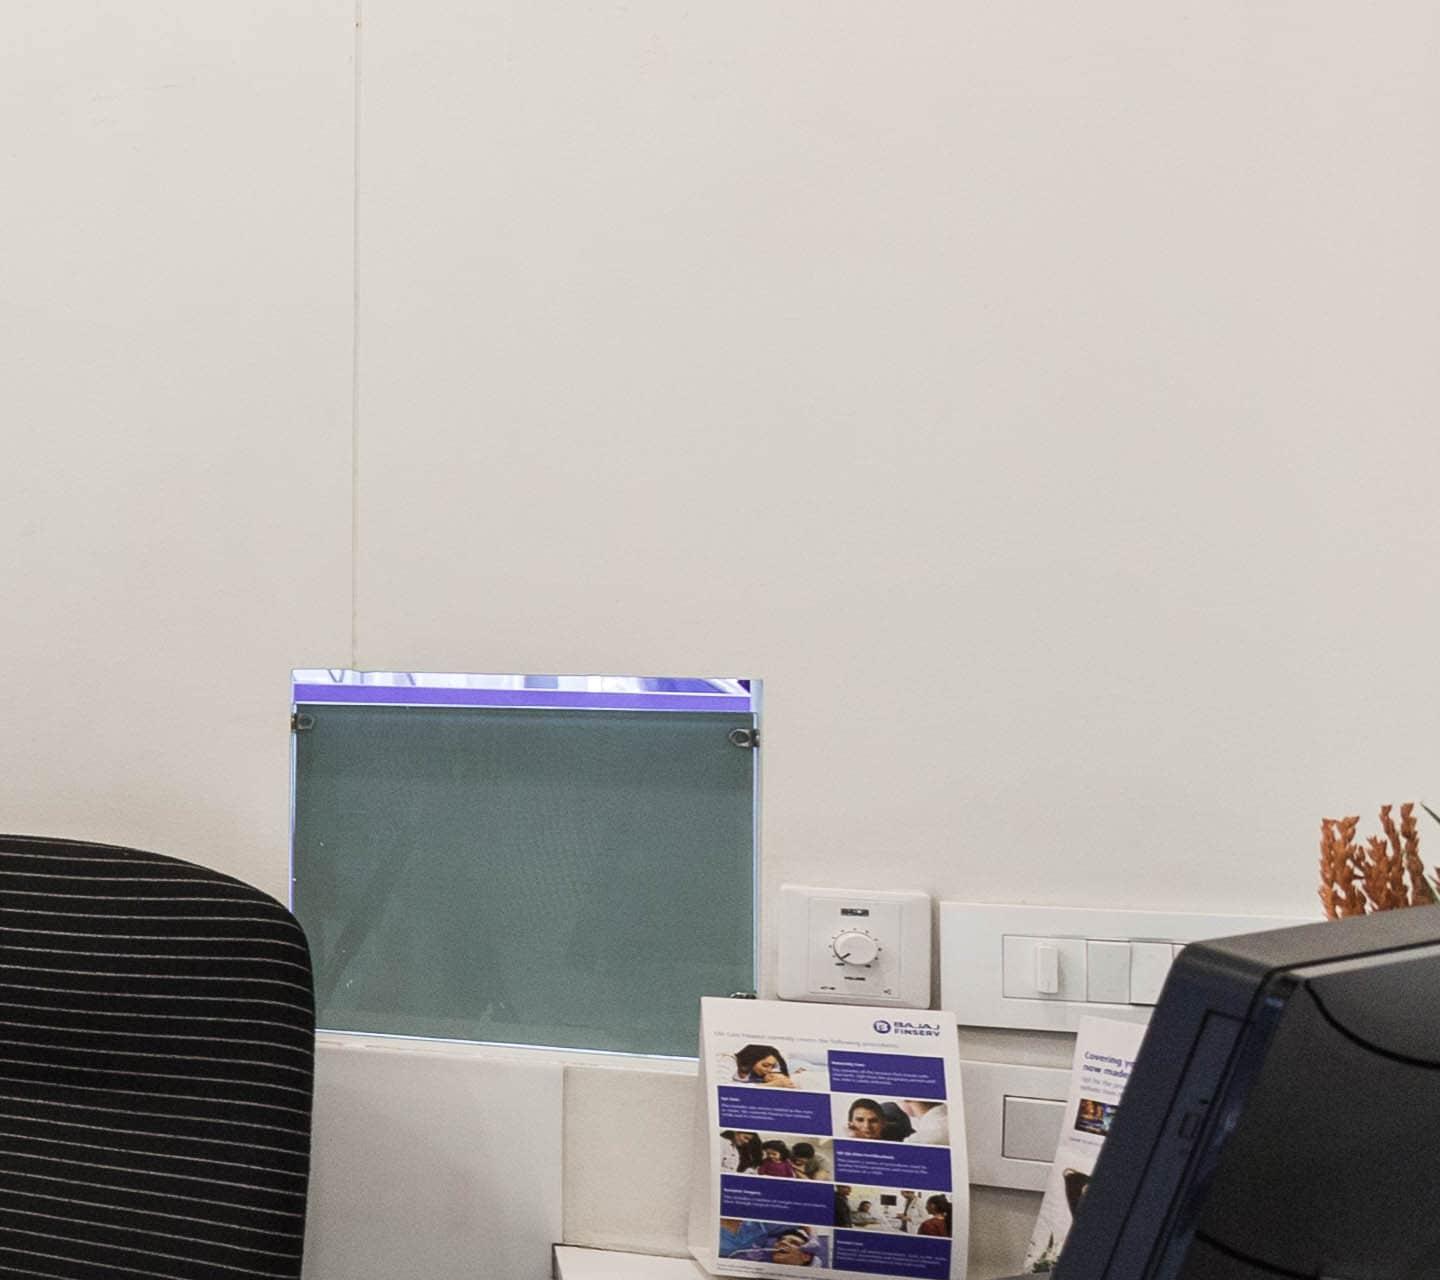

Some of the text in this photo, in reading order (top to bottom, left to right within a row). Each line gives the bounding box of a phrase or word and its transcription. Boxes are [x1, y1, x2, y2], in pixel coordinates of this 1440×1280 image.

[894, 1021, 940, 1030] BAJAJ
[894, 1029, 940, 1037] FINSERV
[1084, 1051, 1121, 1067] Covering
[1083, 1064, 1101, 1073] now
